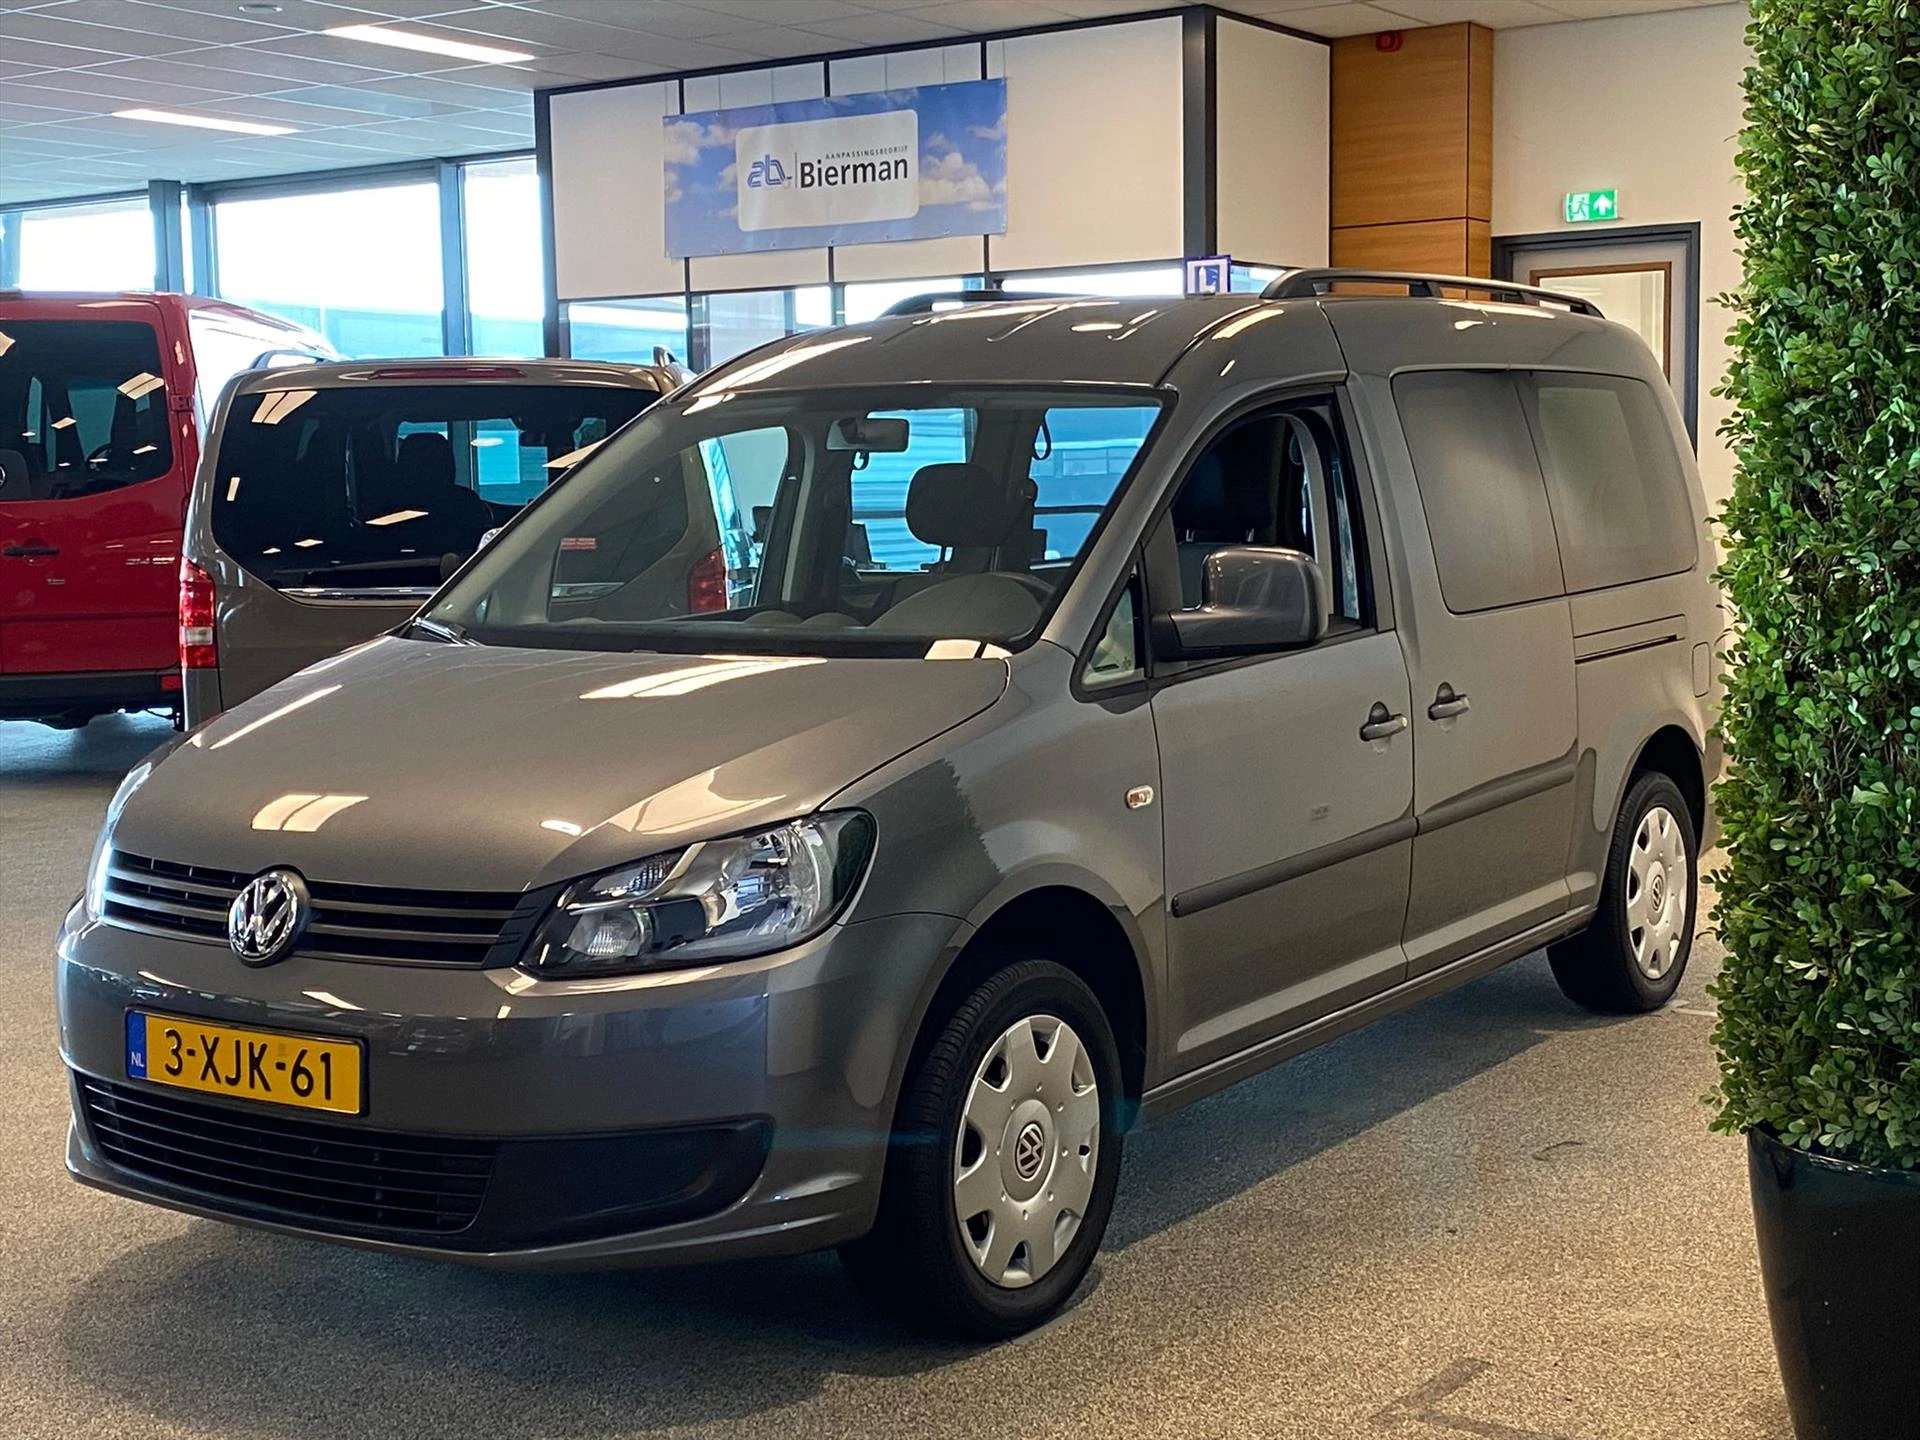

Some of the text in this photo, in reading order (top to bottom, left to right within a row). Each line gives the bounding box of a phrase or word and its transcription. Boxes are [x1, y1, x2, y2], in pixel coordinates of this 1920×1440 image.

[800, 157, 908, 188] Bierman
[131, 1051, 145, 1068] NL
[164, 1028, 332, 1101] 3-XJK-61
